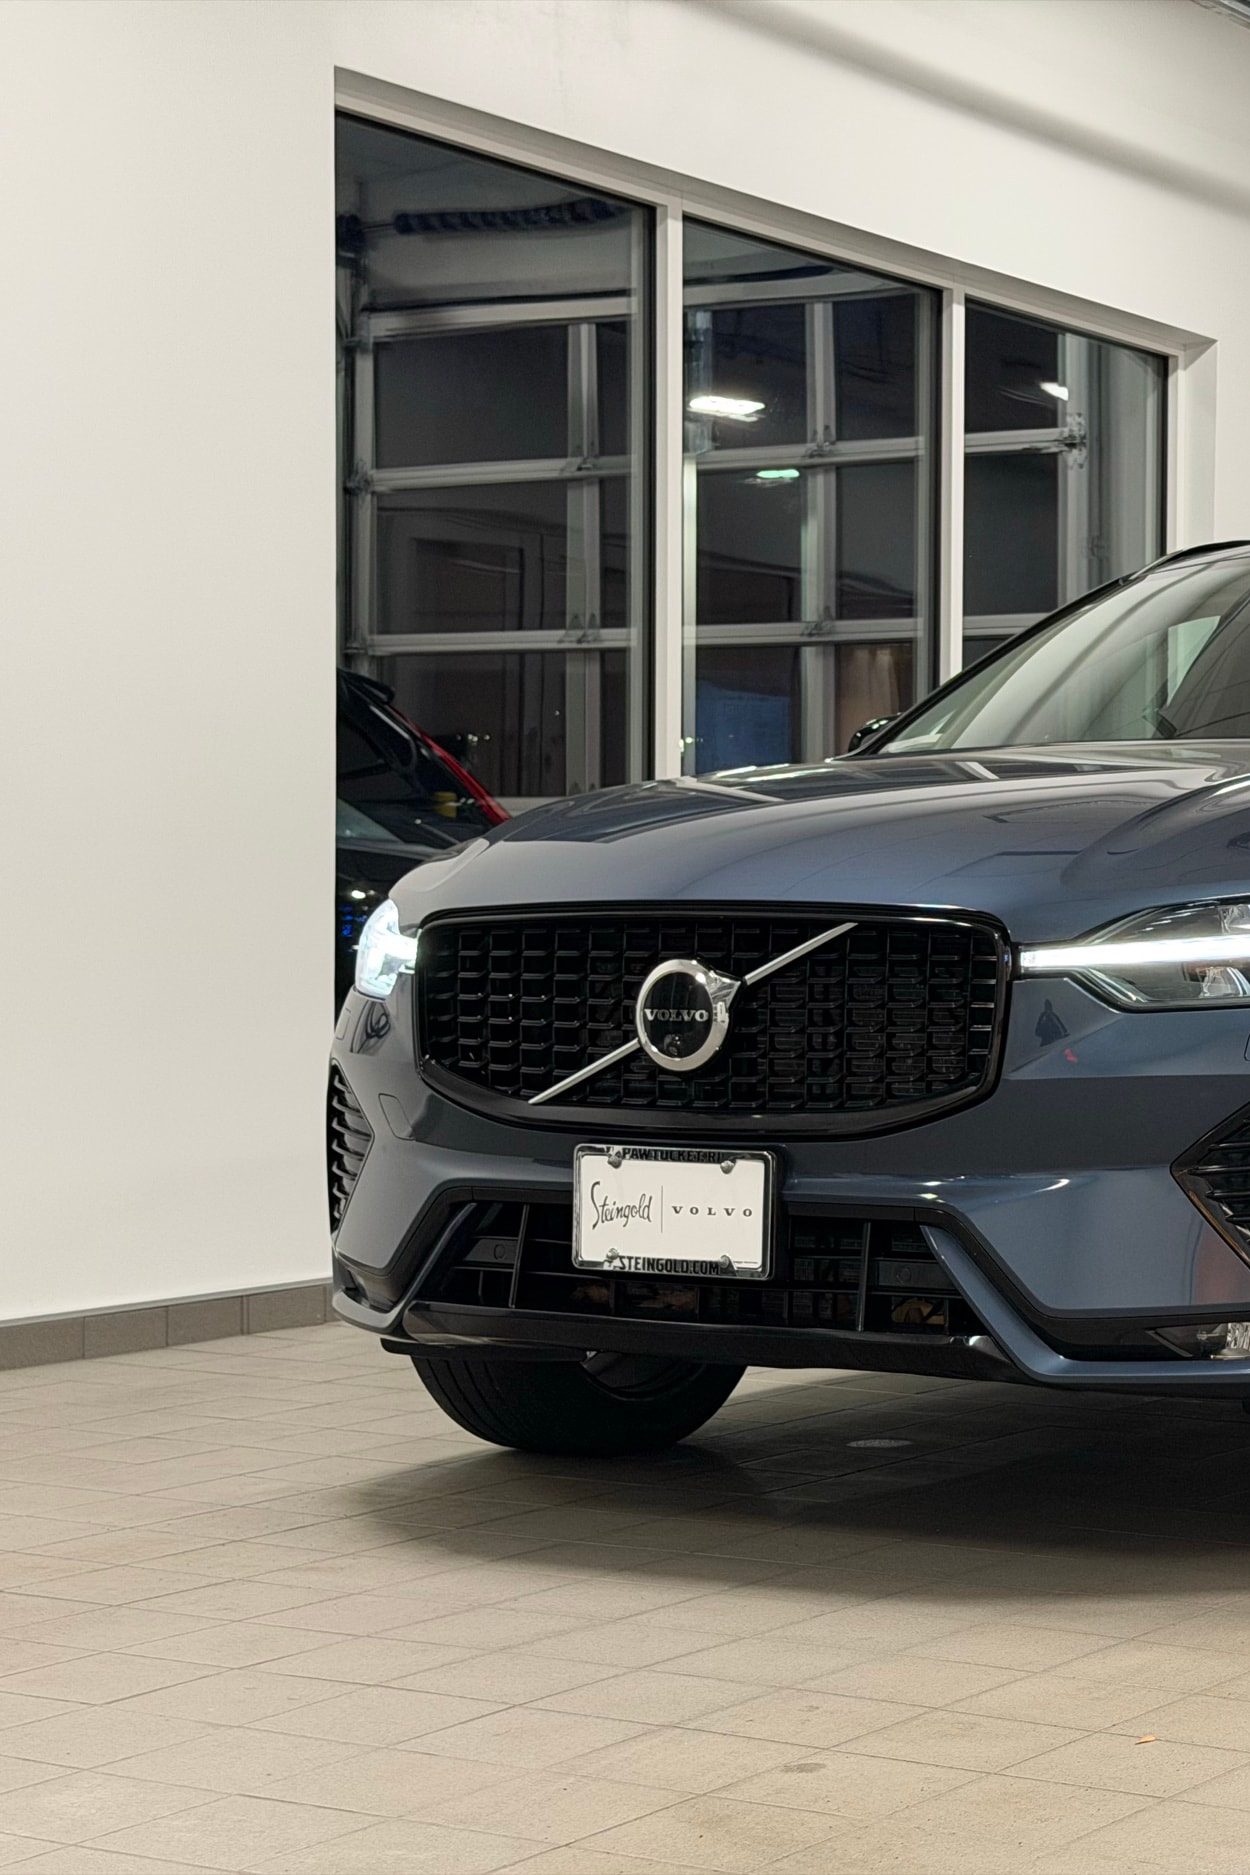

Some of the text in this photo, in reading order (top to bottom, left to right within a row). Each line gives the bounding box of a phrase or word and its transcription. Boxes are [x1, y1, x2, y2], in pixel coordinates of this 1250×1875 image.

[644, 1008, 710, 1022] VOLVO
[590, 1180, 753, 1230] Steingold VOLVO
[618, 1254, 720, 1276] STEINGOLD.COM
